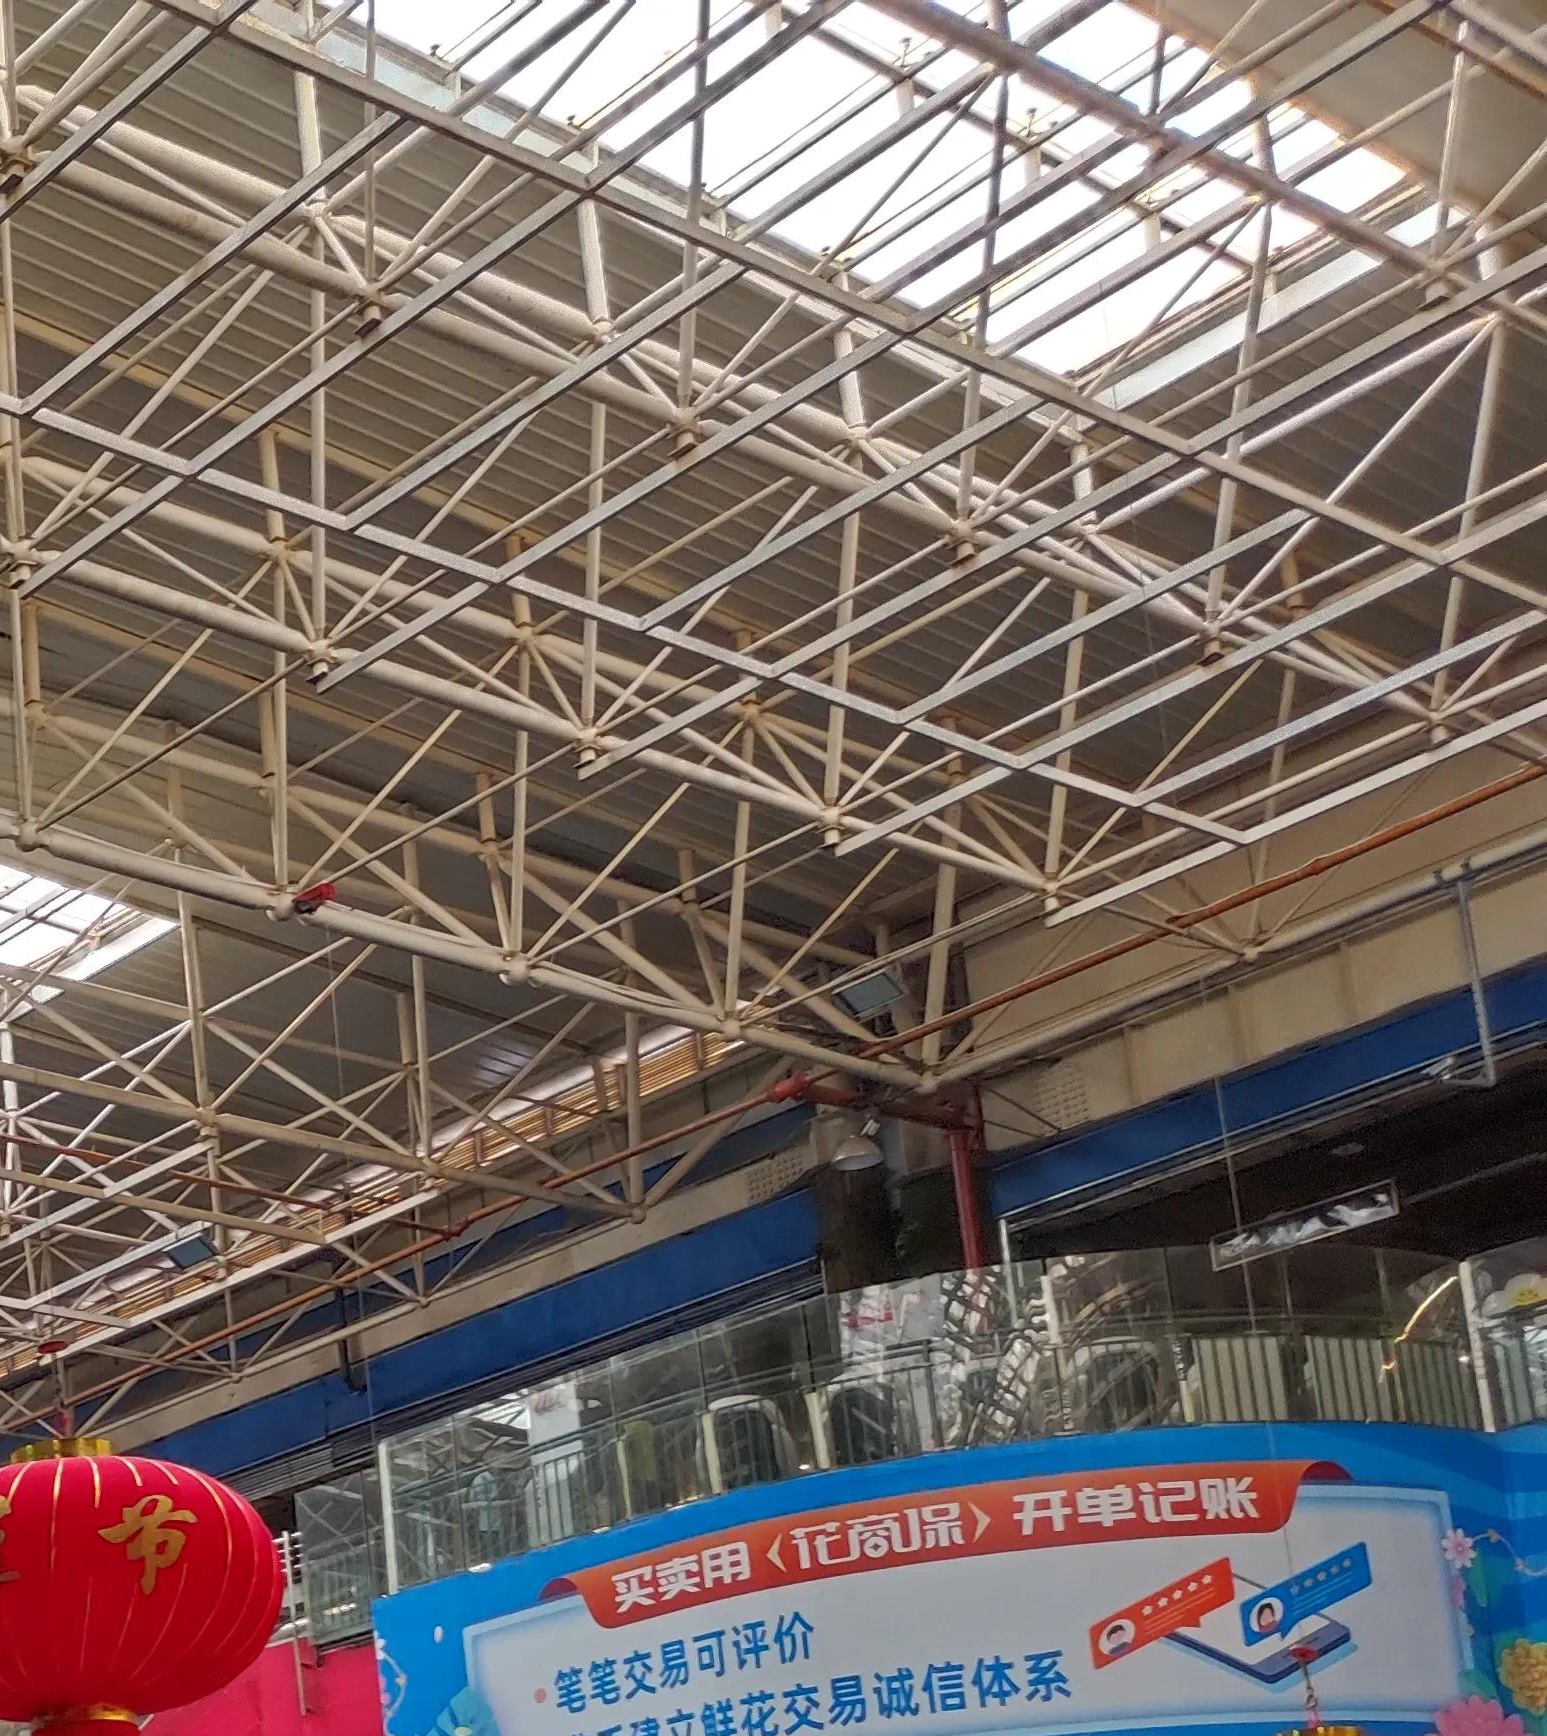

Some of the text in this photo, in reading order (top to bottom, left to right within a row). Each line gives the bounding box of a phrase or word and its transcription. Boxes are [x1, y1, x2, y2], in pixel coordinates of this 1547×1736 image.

[552, 1612, 816, 1716] 笔笔交易可评价
